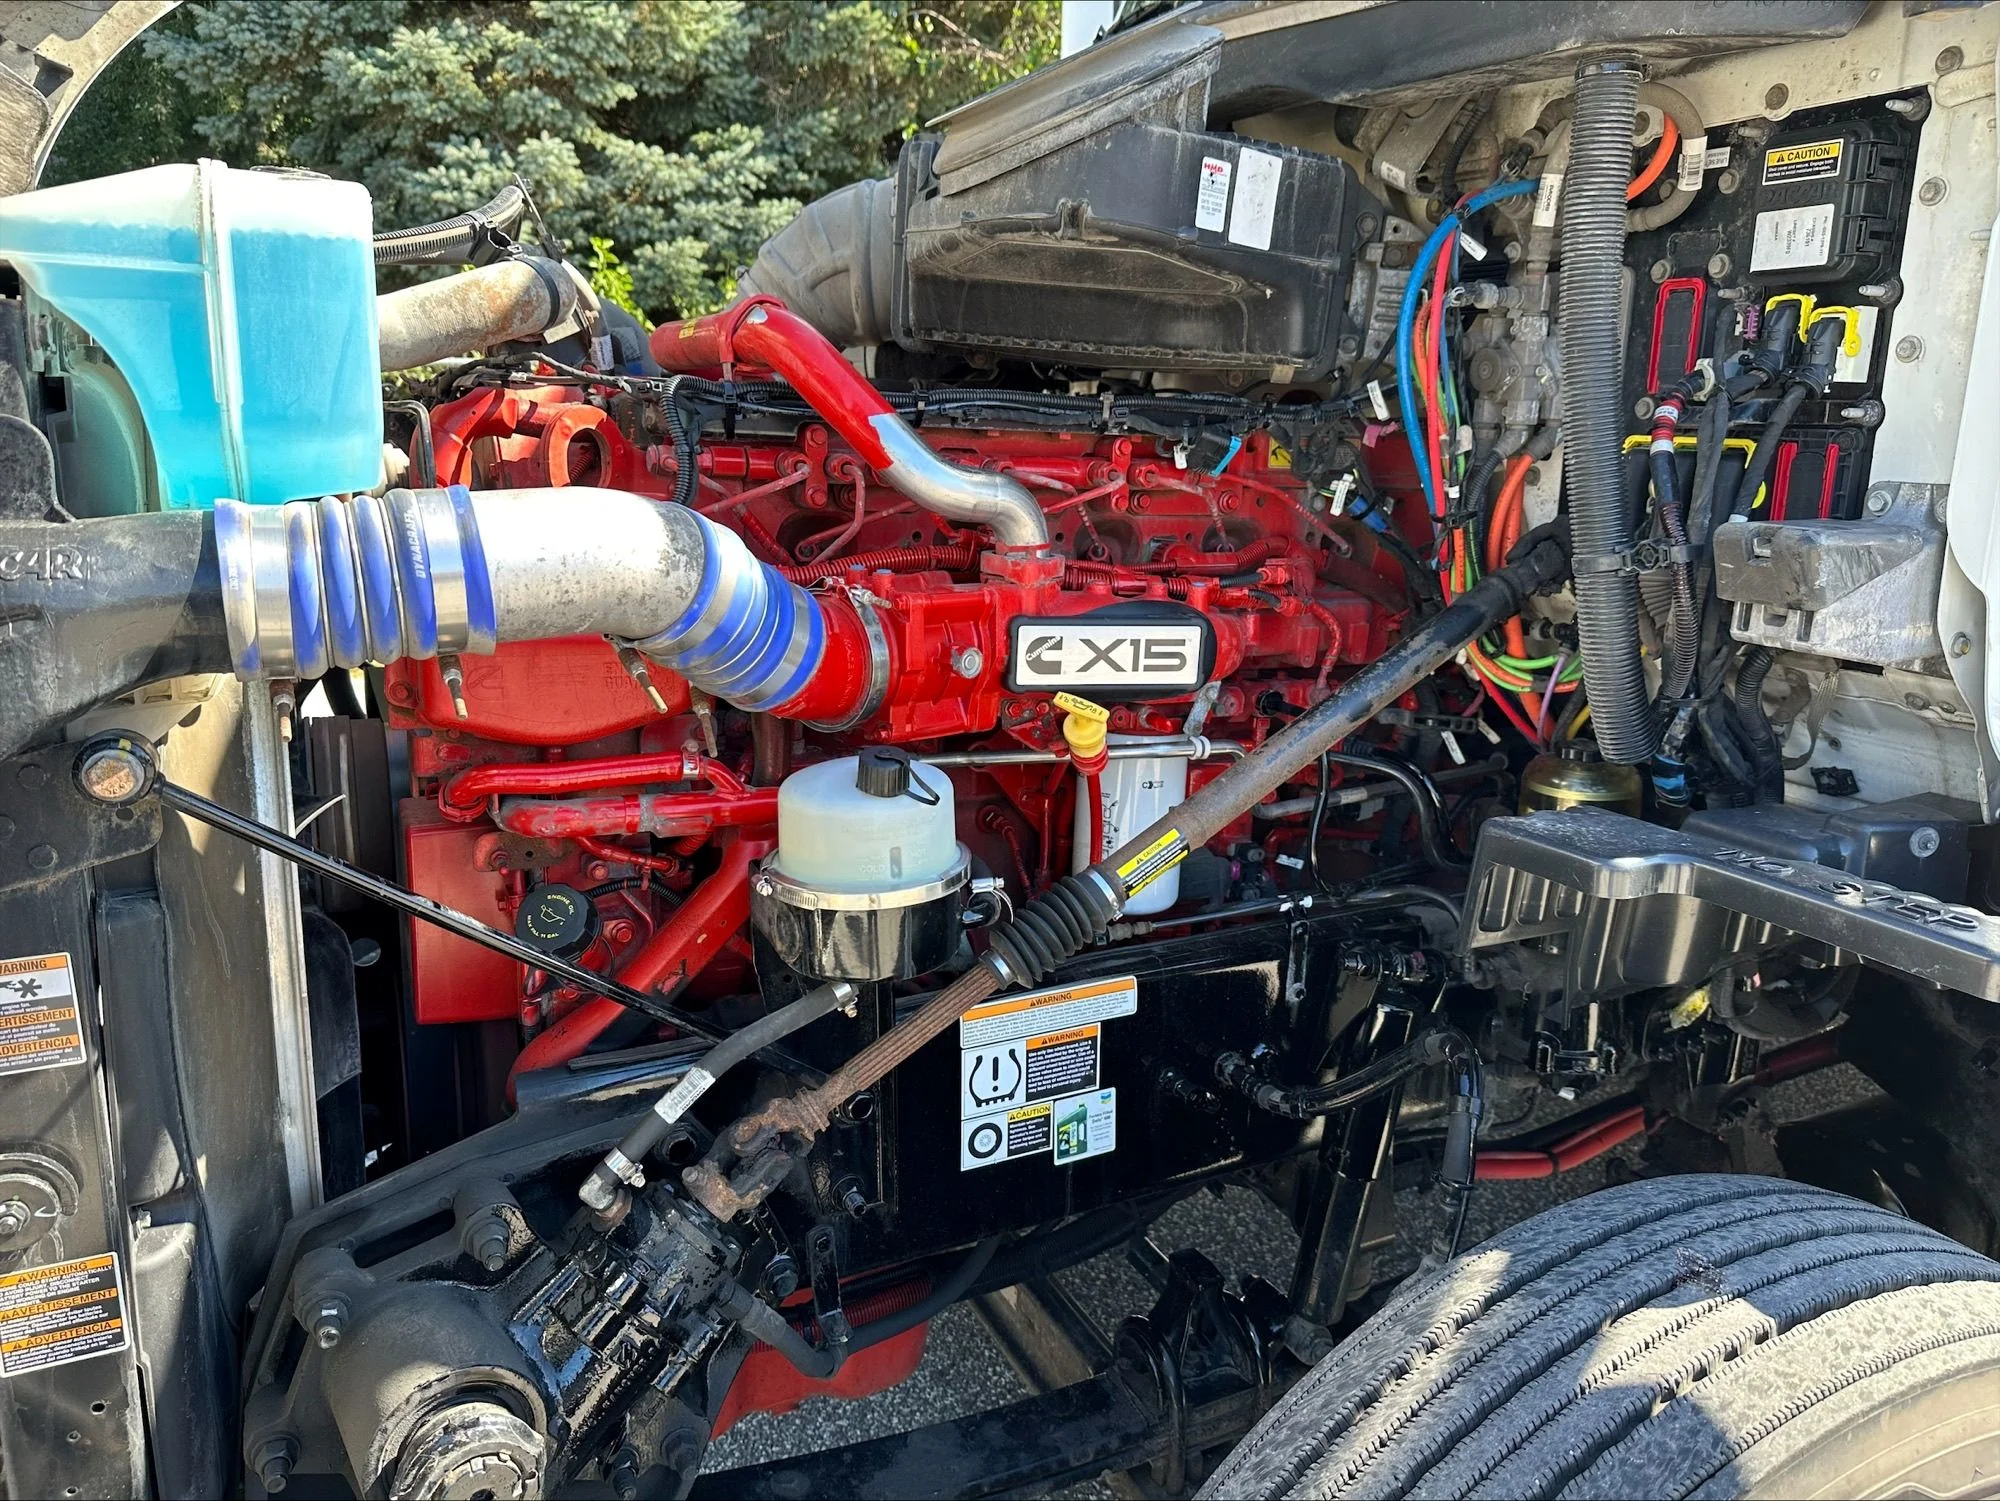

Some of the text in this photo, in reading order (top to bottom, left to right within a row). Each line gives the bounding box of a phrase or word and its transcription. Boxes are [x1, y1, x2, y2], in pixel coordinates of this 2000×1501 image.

[1788, 146, 1830, 161] CAUTION
[1025, 636, 1187, 672] Cummins X15
[1713, 847, 1981, 932] NO STEP
[547, 894, 570, 905] ENGINE
[0, 960, 48, 975] ARNING
[1036, 992, 1072, 1006] WARNING
[0, 1008, 73, 1028] ERTISSEMENT
[1048, 1030, 1083, 1043] WARNING
[1016, 1106, 1050, 1119] CAUTION
[26, 1262, 88, 1280] WARNING
[12, 1290, 112, 1317] AVERTISSEMENT
[26, 1322, 112, 1346] ADVERTENCIA
